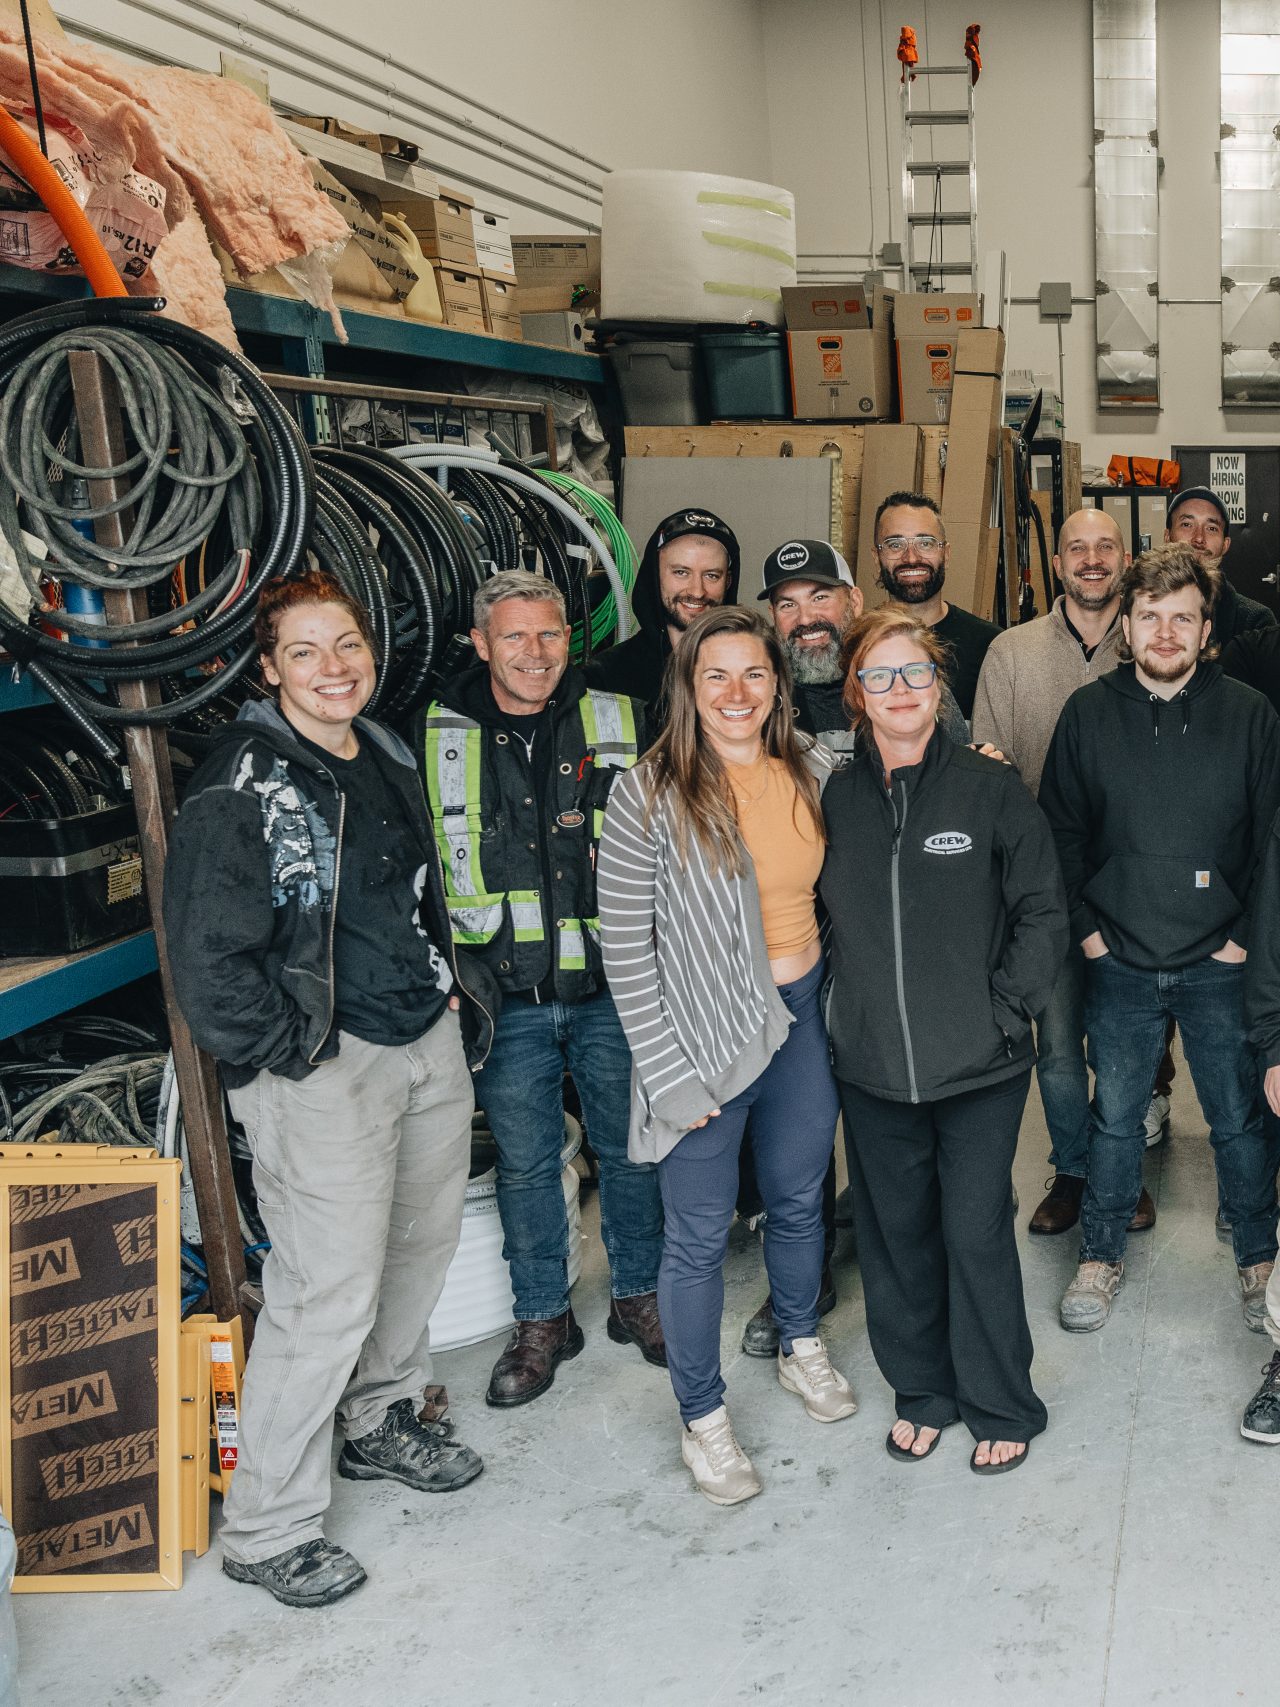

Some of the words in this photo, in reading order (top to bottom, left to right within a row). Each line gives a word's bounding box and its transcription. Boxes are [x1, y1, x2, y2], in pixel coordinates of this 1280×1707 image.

[1216, 456, 1240, 470] NOW
[1211, 473, 1244, 486] HIRING
[1218, 491, 1240, 504] NOW
[1228, 511, 1244, 521] ING
[780, 551, 805, 561] CREW
[931, 836, 967, 846] CREW
